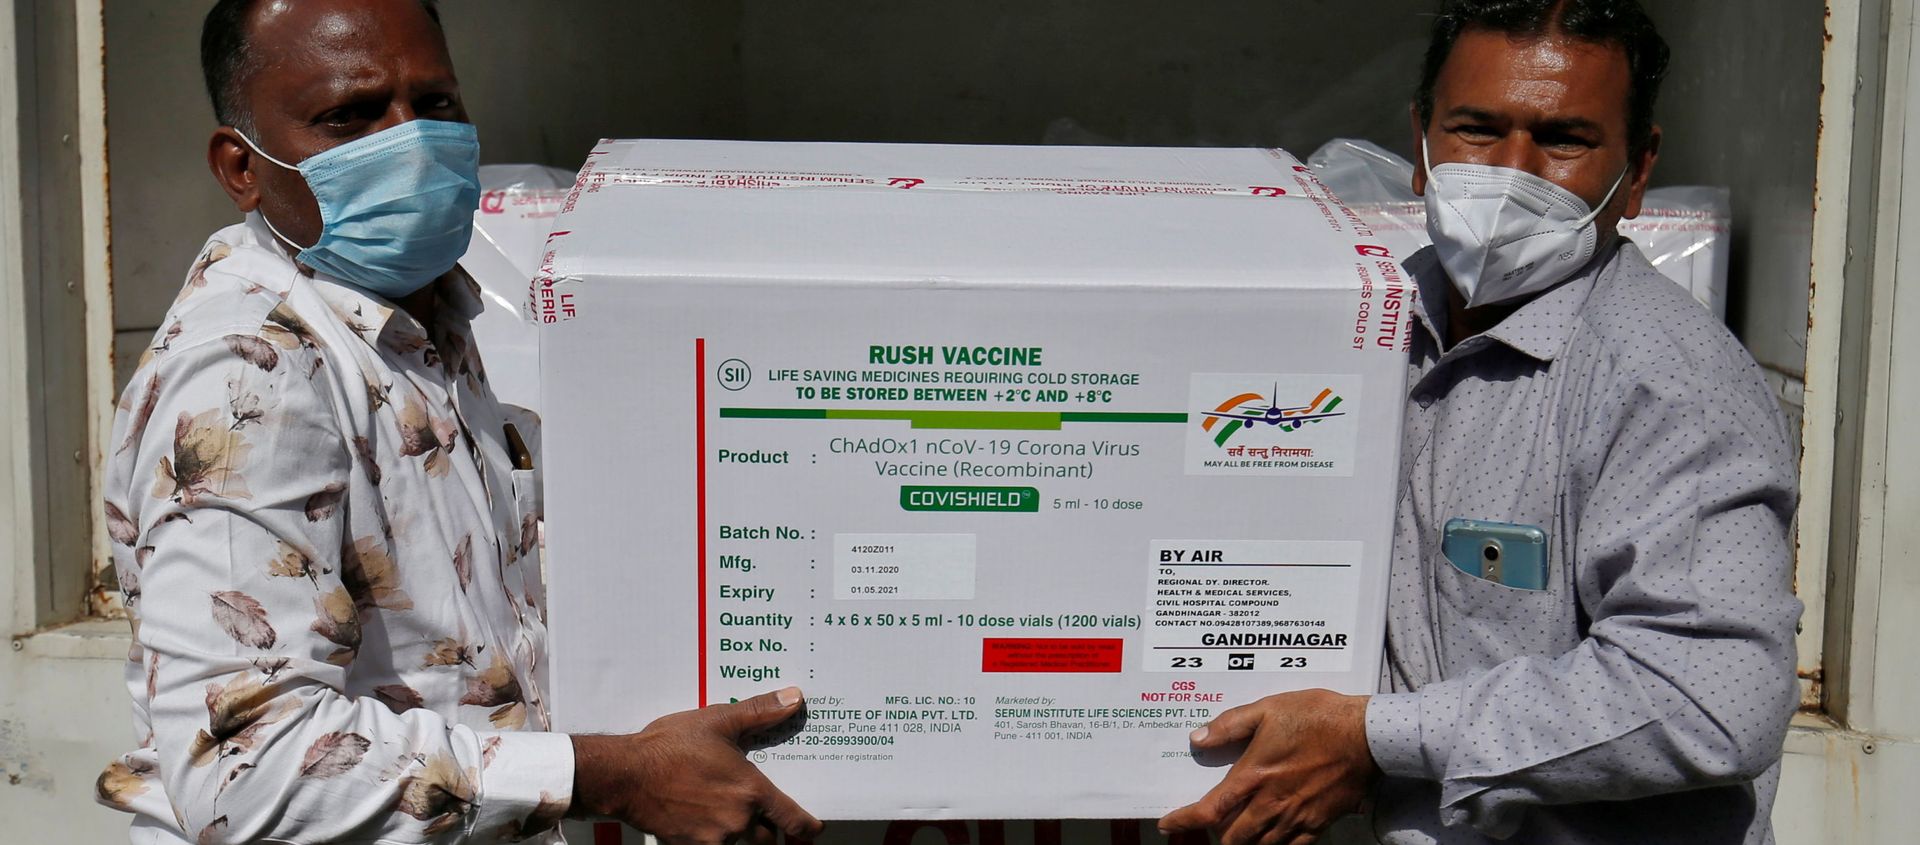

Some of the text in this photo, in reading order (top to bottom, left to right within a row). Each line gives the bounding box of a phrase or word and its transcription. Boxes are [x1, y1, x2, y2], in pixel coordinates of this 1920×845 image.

[561, 294, 576, 321] LIF
[1377, 281, 1404, 351] INSTITU
[870, 346, 1042, 366] RUSH VACCINE
[725, 368, 744, 382] SII
[769, 370, 1139, 385] LIFE SAVING MEDICINES REQUIRING COLD STORAGE
[796, 387, 815, 399] TO
[821, 387, 841, 399] BE
[846, 387, 908, 400] STORED
[914, 388, 987, 401] BETWEEN
[1036, 390, 1068, 402] AND
[830, 438, 916, 453] ChAdOx1
[1018, 440, 1085, 455] Corona
[1092, 441, 1139, 456] Virus
[719, 450, 788, 463] Product
[875, 461, 1092, 479] Vaccine (Recombinant)
[910, 490, 1021, 507] COVISHIELD
[1053, 499, 1061, 509] 5
[1066, 499, 1080, 509] ml
[1094, 499, 1108, 509] 10
[1112, 499, 1143, 509] dose
[720, 526, 769, 539] Batch
[776, 526, 804, 539] No.
[1160, 550, 1222, 562] BY AIR
[720, 556, 756, 572] Mfg.
[720, 585, 774, 602] Expiry
[720, 613, 792, 629] Quantity
[825, 614, 833, 625] 4
[838, 617, 845, 625] x
[851, 614, 859, 626] 6
[864, 617, 872, 625] x
[877, 614, 894, 626] 50
[899, 617, 907, 626] x
[912, 614, 920, 626] 5
[925, 614, 942, 626] ml
[958, 614, 974, 626] 10
[979, 614, 1014, 626] dose
[1020, 615, 1053, 627] vials
[1058, 615, 1097, 630] (1200
[1102, 615, 1141, 630] vials)
[721, 639, 752, 651] Box
[760, 639, 787, 651] No.
[1202, 633, 1347, 646] GANDHINAGAR
[1171, 657, 1307, 667] 23 OF 23
[720, 666, 780, 682] Weight
[1172, 682, 1195, 690] CGS
[829, 696, 844, 706] by:
[886, 696, 911, 704] MFG.
[1041, 697, 1056, 706] by:
[1142, 693, 1223, 702] NOT FOR SALE
[866, 710, 882, 720] OF
[886, 710, 917, 719] INDIA
[922, 711, 947, 719] PVT.
[952, 711, 977, 720] LTD.
[995, 709, 1211, 718] SERUM INSTITUTE LIFE SCIENCES PVT. LTD.
[849, 723, 876, 732] Pune
[880, 723, 898, 732] 411
[903, 723, 925, 733] 028,
[930, 723, 961, 732] INDIA
[994, 721, 1013, 729] 401,
[1050, 721, 1086, 729] Bhavan,
[1045, 732, 1063, 740] 001,
[846, 754, 893, 762] registration
